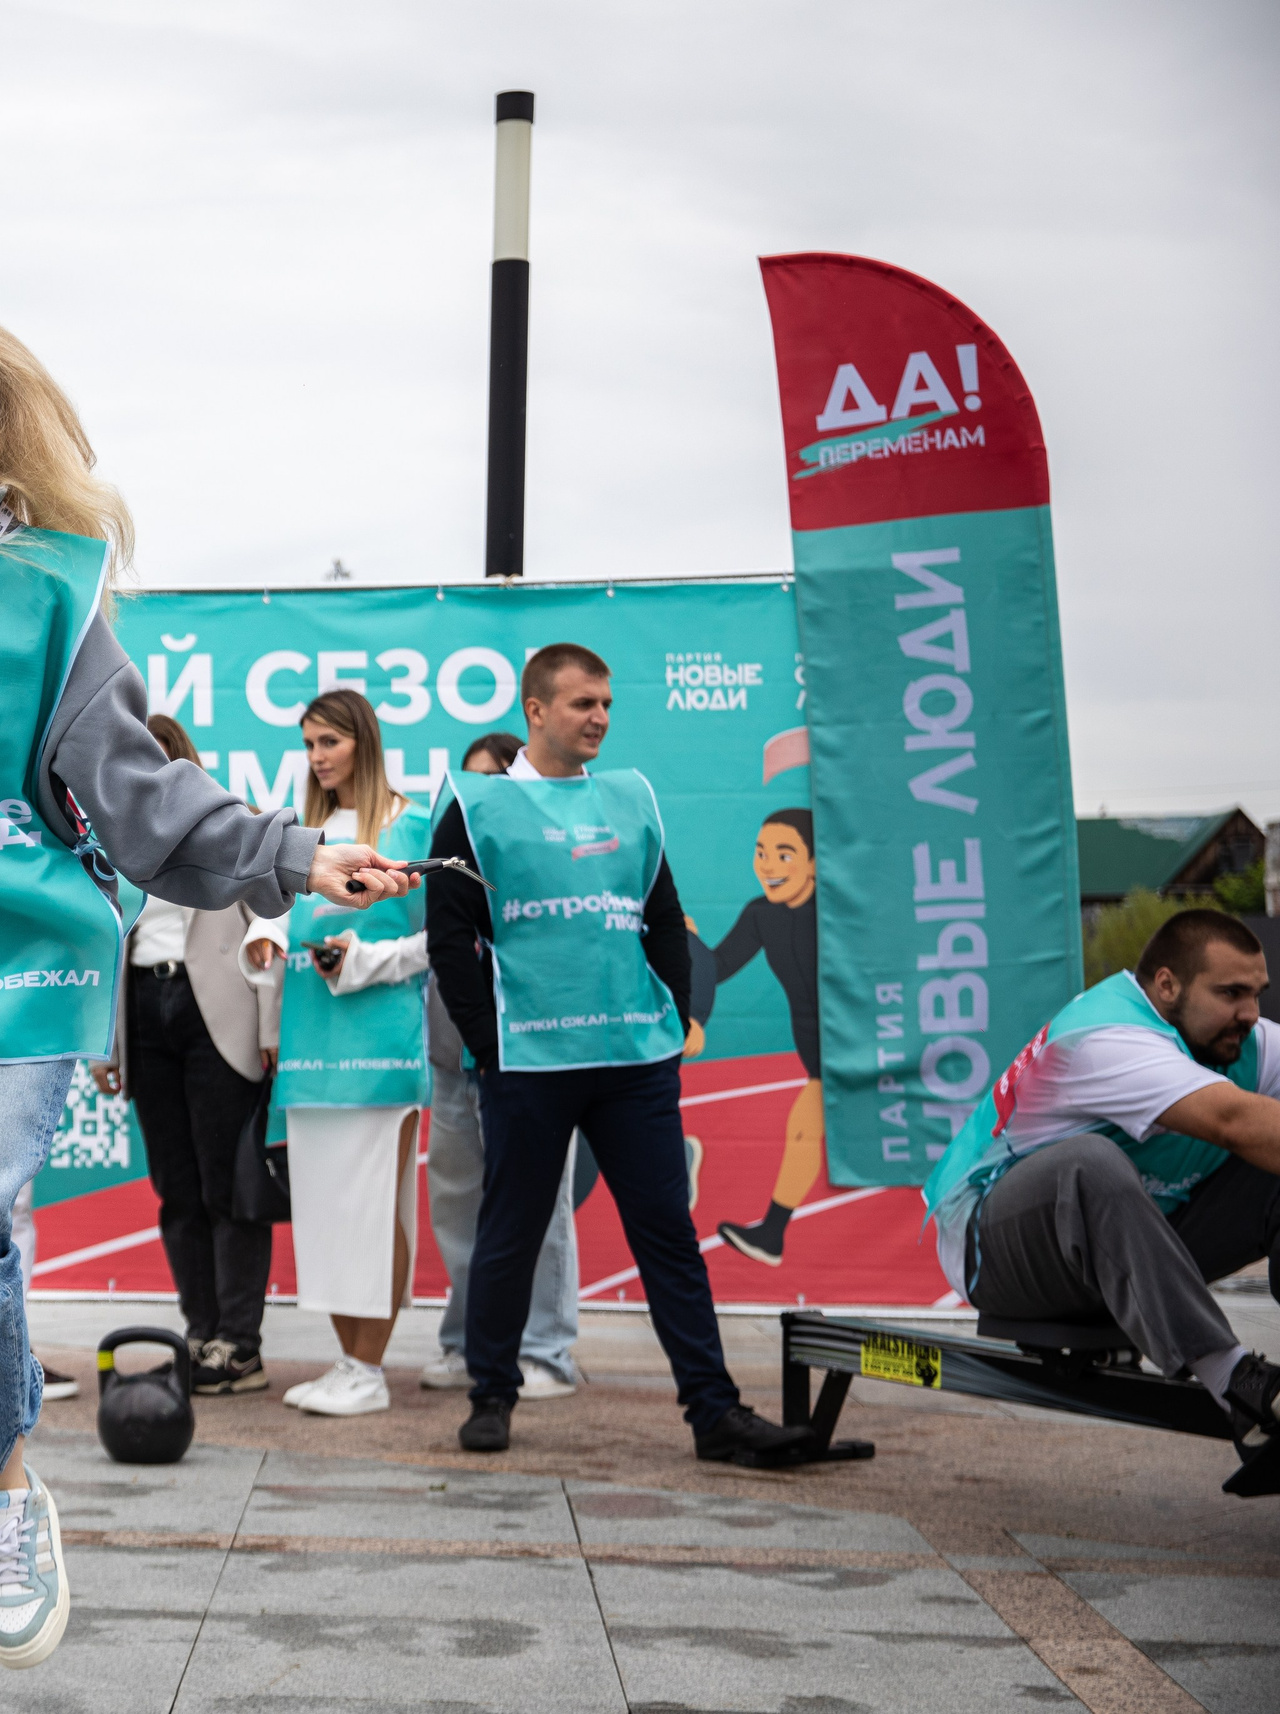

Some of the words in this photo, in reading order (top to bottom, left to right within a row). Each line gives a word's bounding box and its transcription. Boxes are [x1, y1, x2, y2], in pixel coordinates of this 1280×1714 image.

[815, 343, 983, 432] ДА!
[818, 424, 987, 467] ПЕРЕМЕНАМ
[245, 646, 536, 728] СЕЗО
[664, 662, 764, 688] НОВЫЕ
[665, 652, 723, 663] ПАРТИЯ
[891, 546, 979, 815] ЛЮДИ
[666, 687, 748, 712] ЛЮДИ
[875, 982, 911, 1162] ПАРТИЯ
